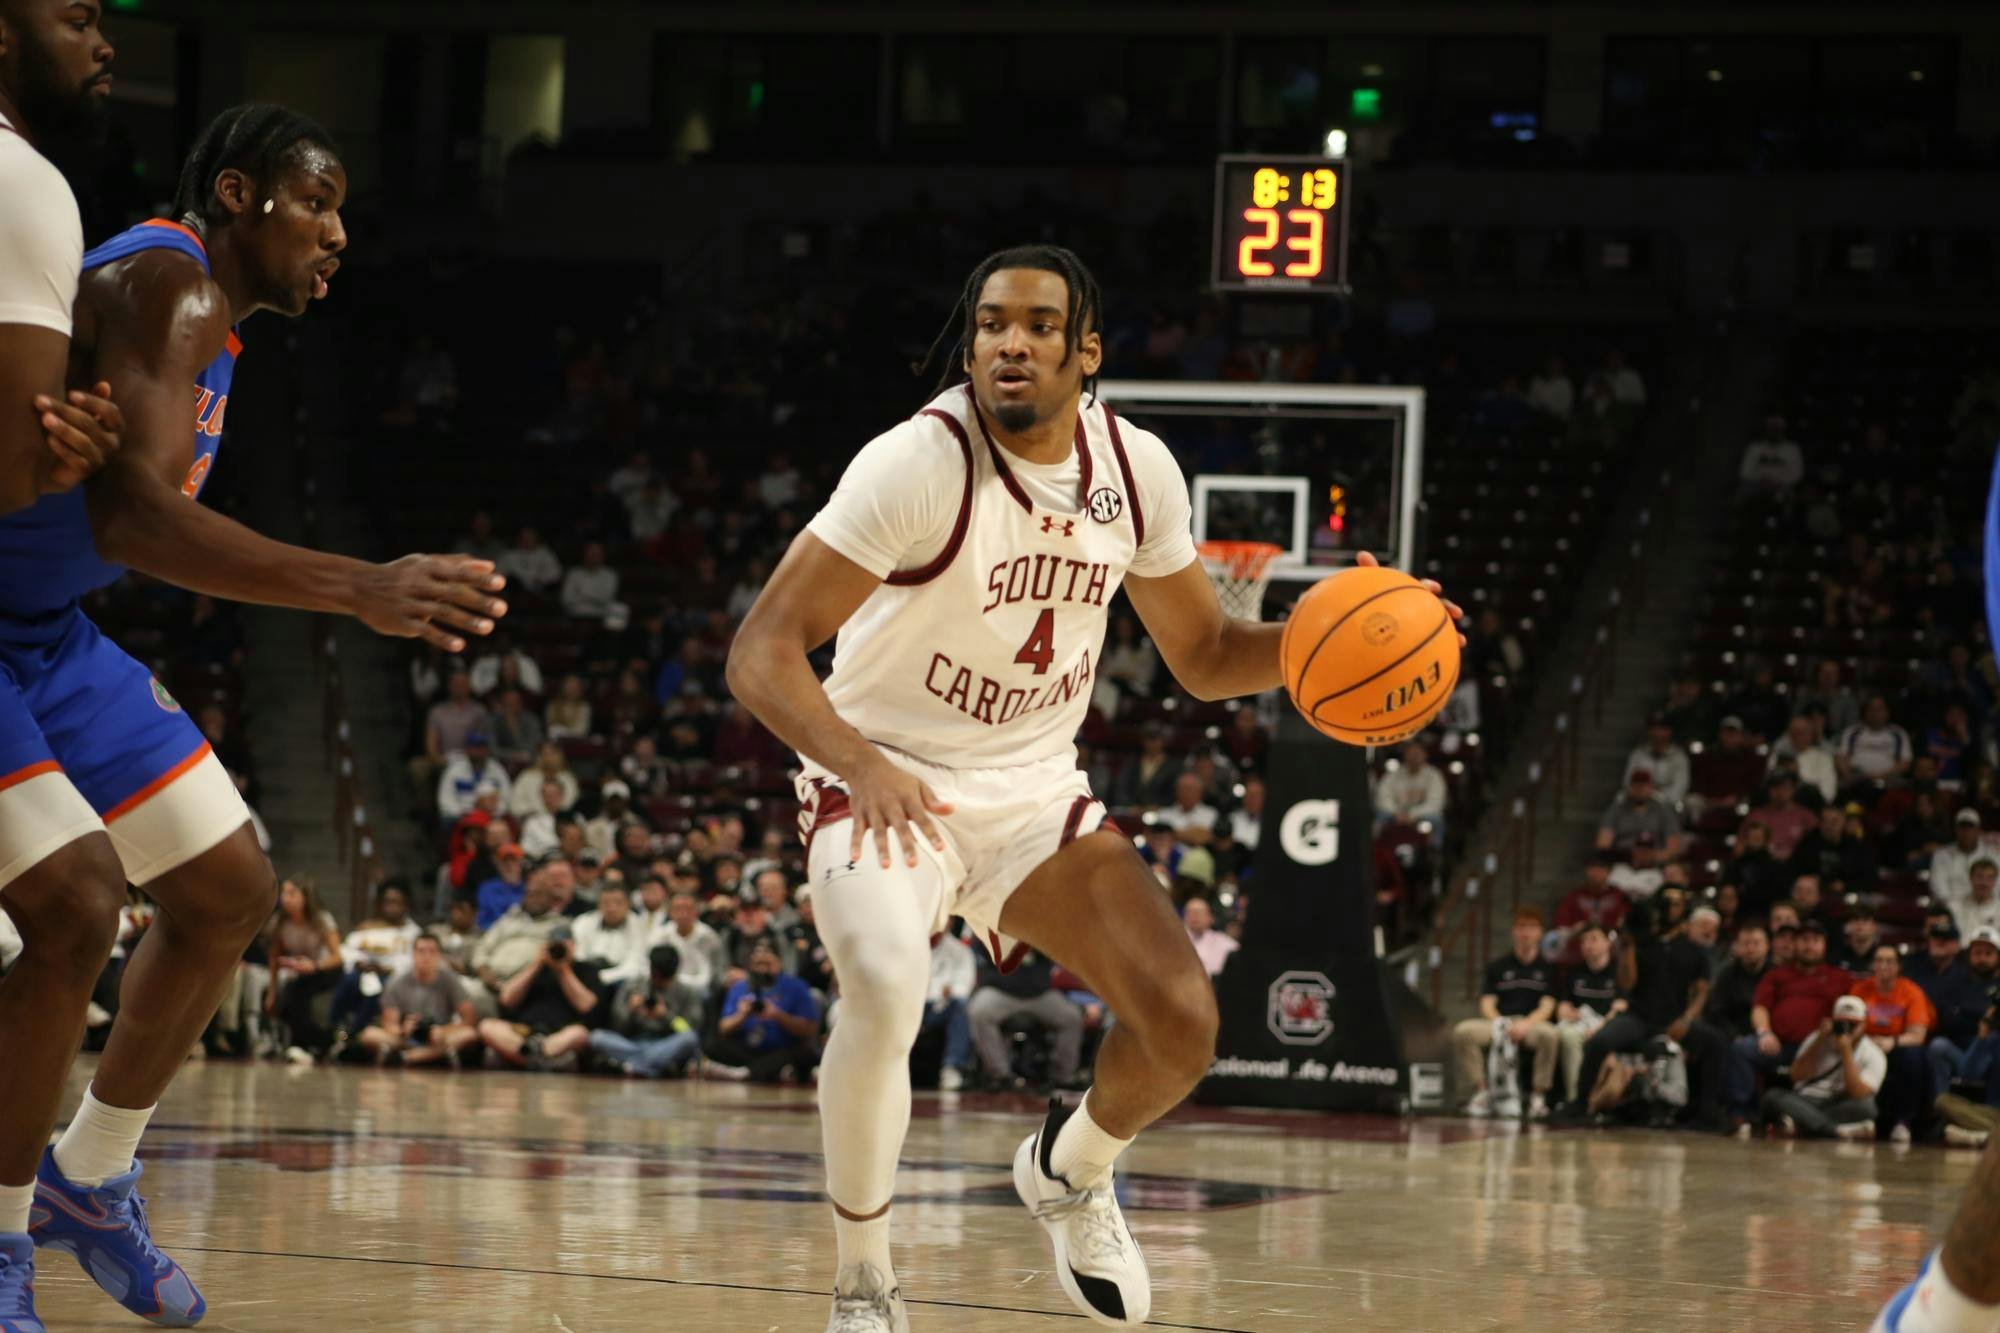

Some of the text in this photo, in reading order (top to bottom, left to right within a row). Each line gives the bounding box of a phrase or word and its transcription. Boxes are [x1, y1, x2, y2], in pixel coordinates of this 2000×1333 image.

[1253, 168, 1337, 209] 8:13
[1239, 208, 1324, 277] 23
[1090, 488, 1122, 523] SEC
[983, 554, 1109, 615] SOUTH
[1013, 607, 1055, 675] 4
[925, 648, 1090, 725] CAROLINA
[1330, 1062, 1398, 1086] Arena
